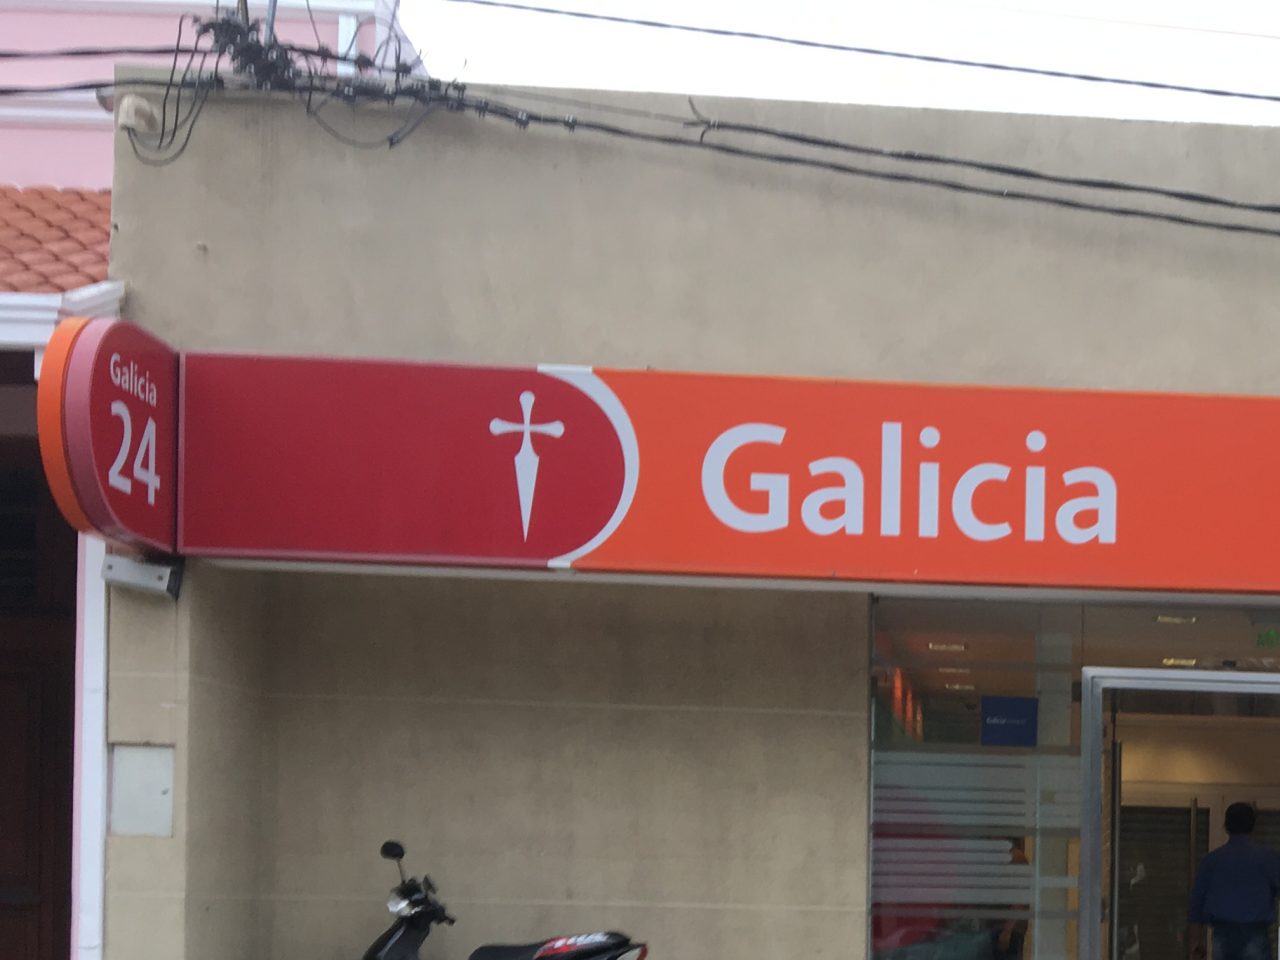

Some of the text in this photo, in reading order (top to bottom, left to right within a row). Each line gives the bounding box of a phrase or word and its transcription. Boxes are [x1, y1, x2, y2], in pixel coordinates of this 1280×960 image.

[110, 352, 157, 408] Galicia
[108, 400, 161, 506] 24
[701, 421, 1118, 545] Galicia
